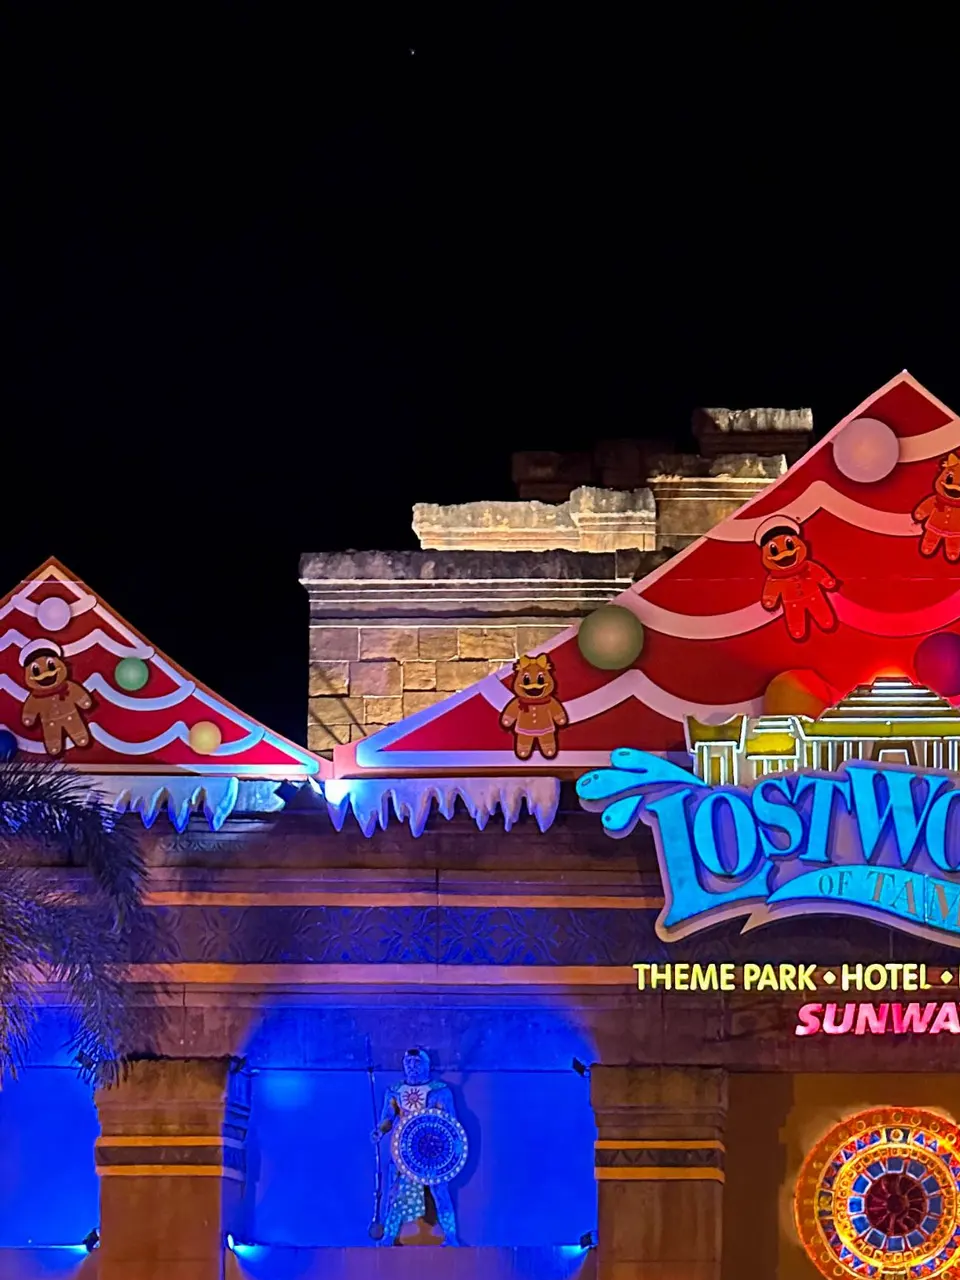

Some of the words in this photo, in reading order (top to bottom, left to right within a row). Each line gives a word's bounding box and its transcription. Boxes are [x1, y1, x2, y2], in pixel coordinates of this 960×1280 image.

[646, 774, 852, 928] LOST
[818, 870, 853, 897] OF
[633, 963, 735, 991] THEME
[743, 963, 817, 991] PARK
[841, 963, 932, 991] HOTEL
